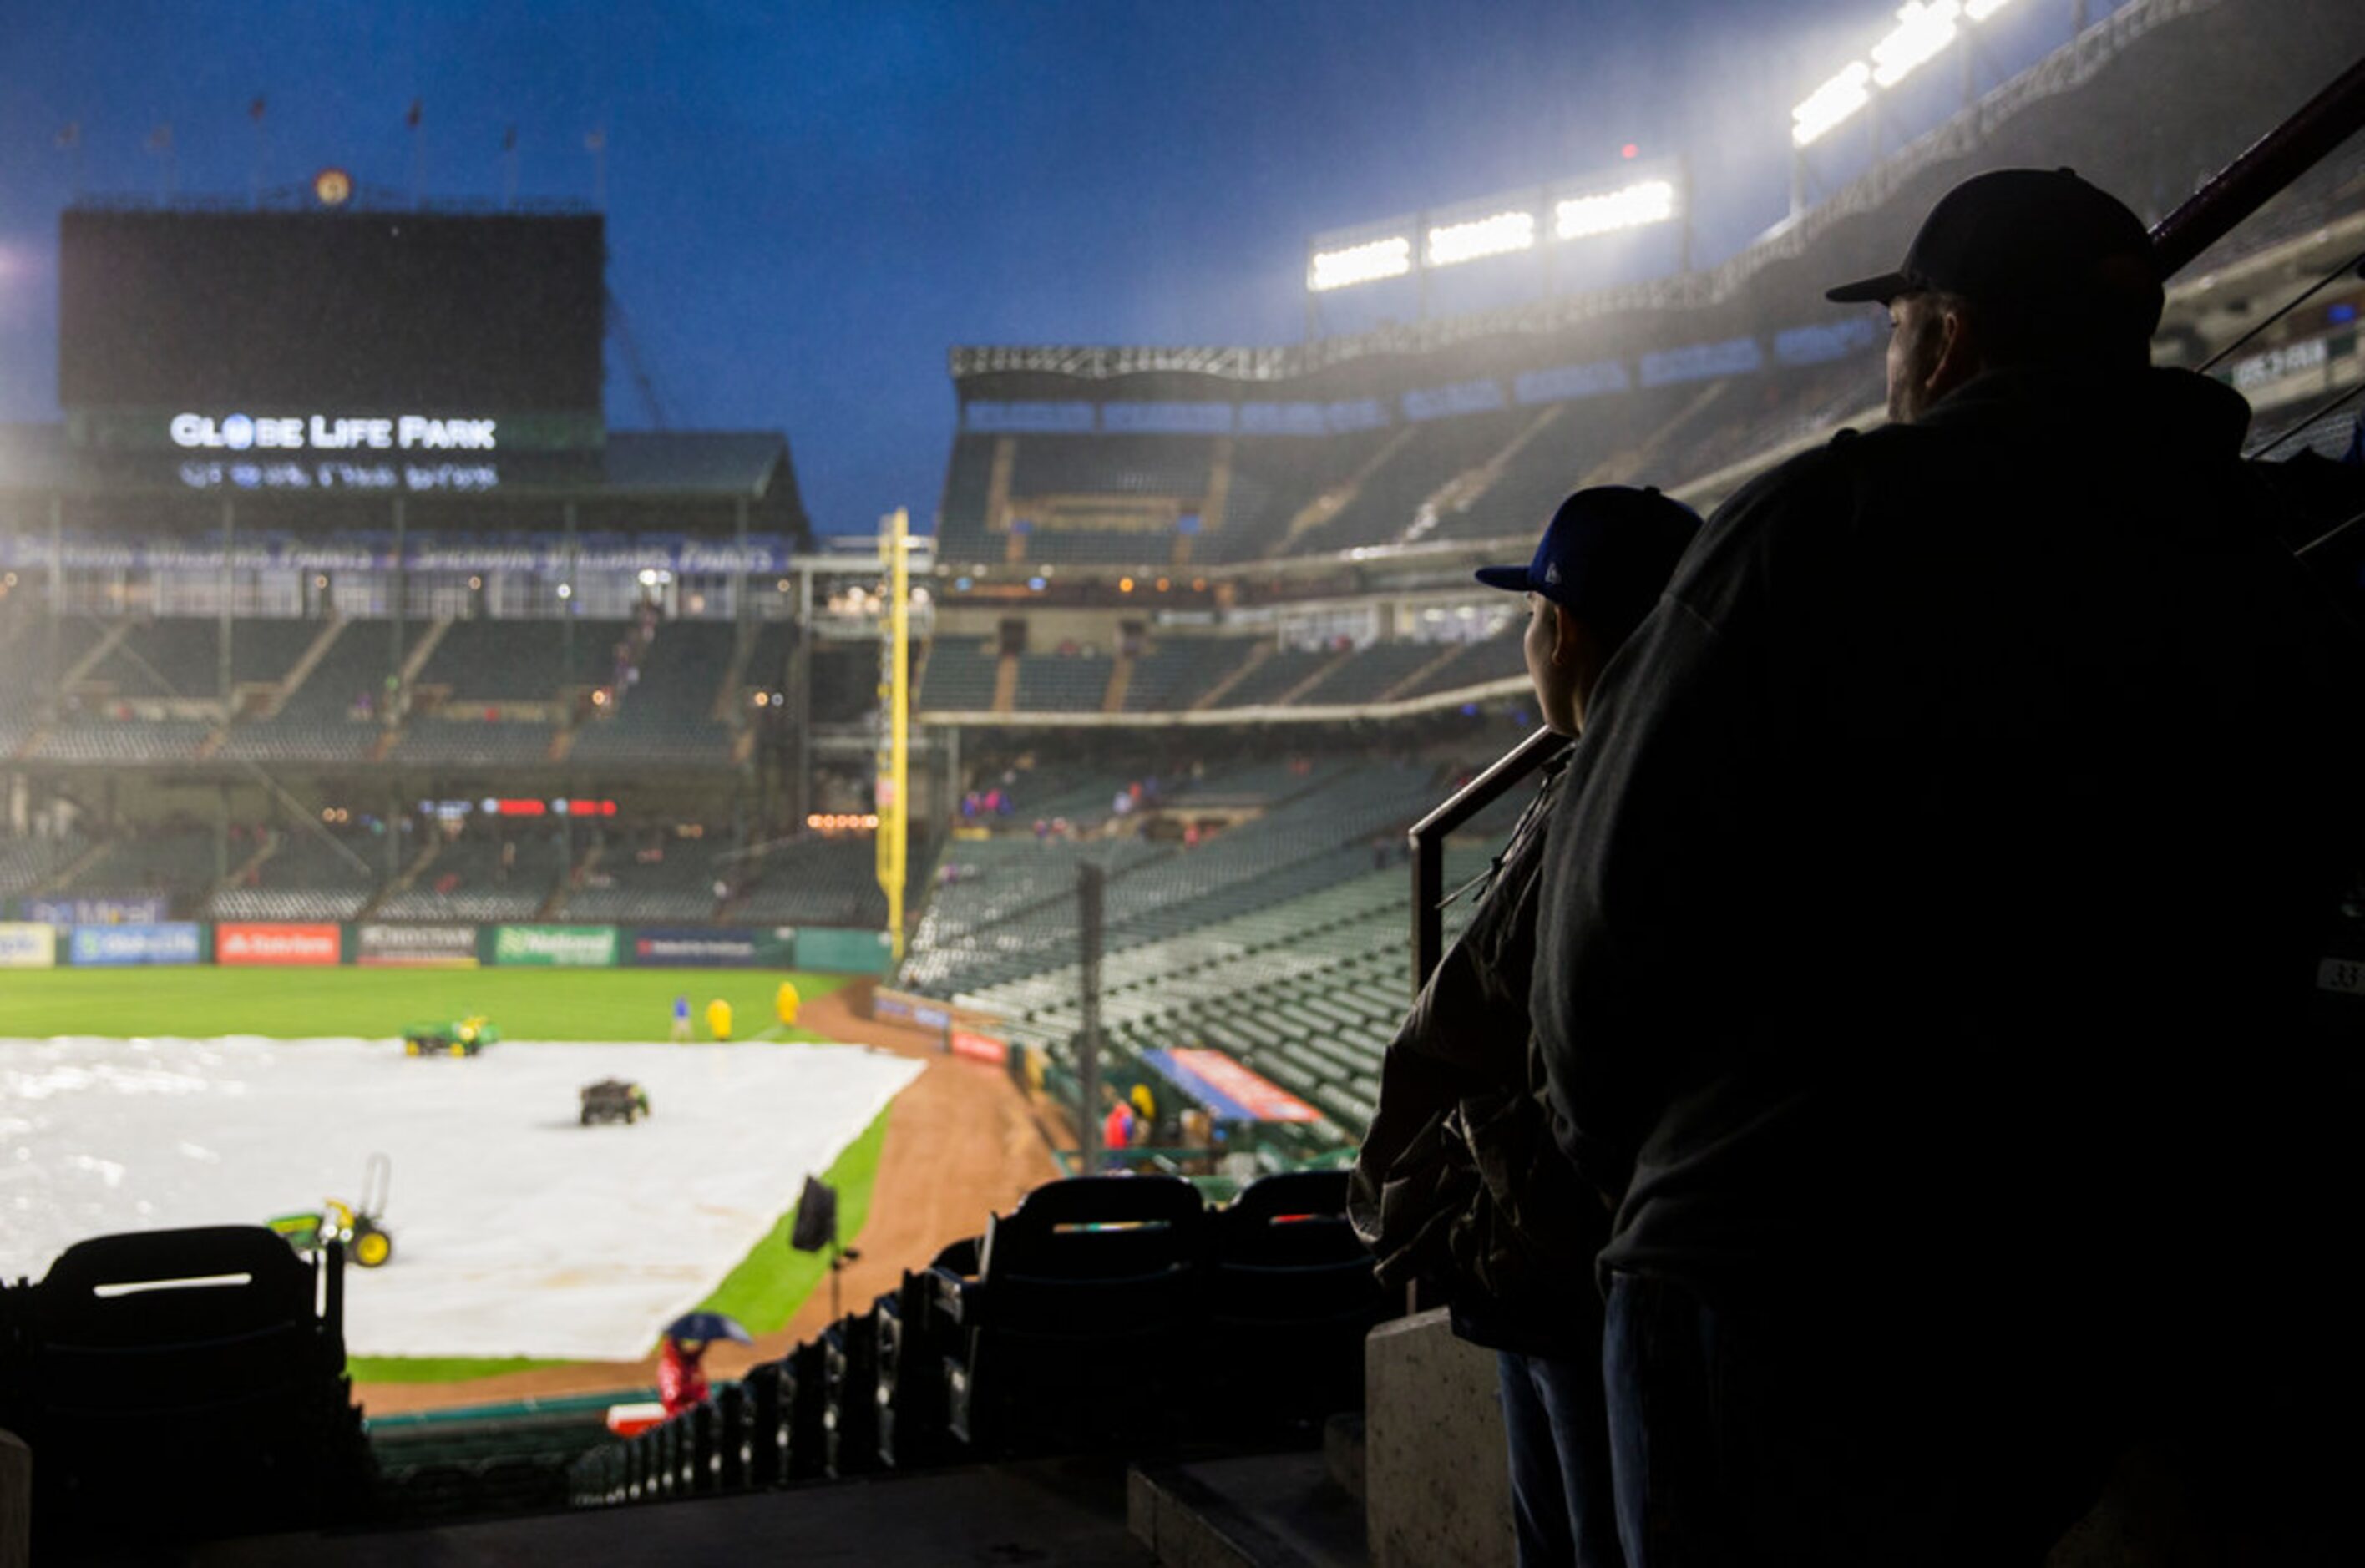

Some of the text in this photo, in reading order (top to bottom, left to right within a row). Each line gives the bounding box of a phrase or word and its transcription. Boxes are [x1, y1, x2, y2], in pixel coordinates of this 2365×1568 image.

[170, 413, 495, 449] GLOBE LIFE PARK
